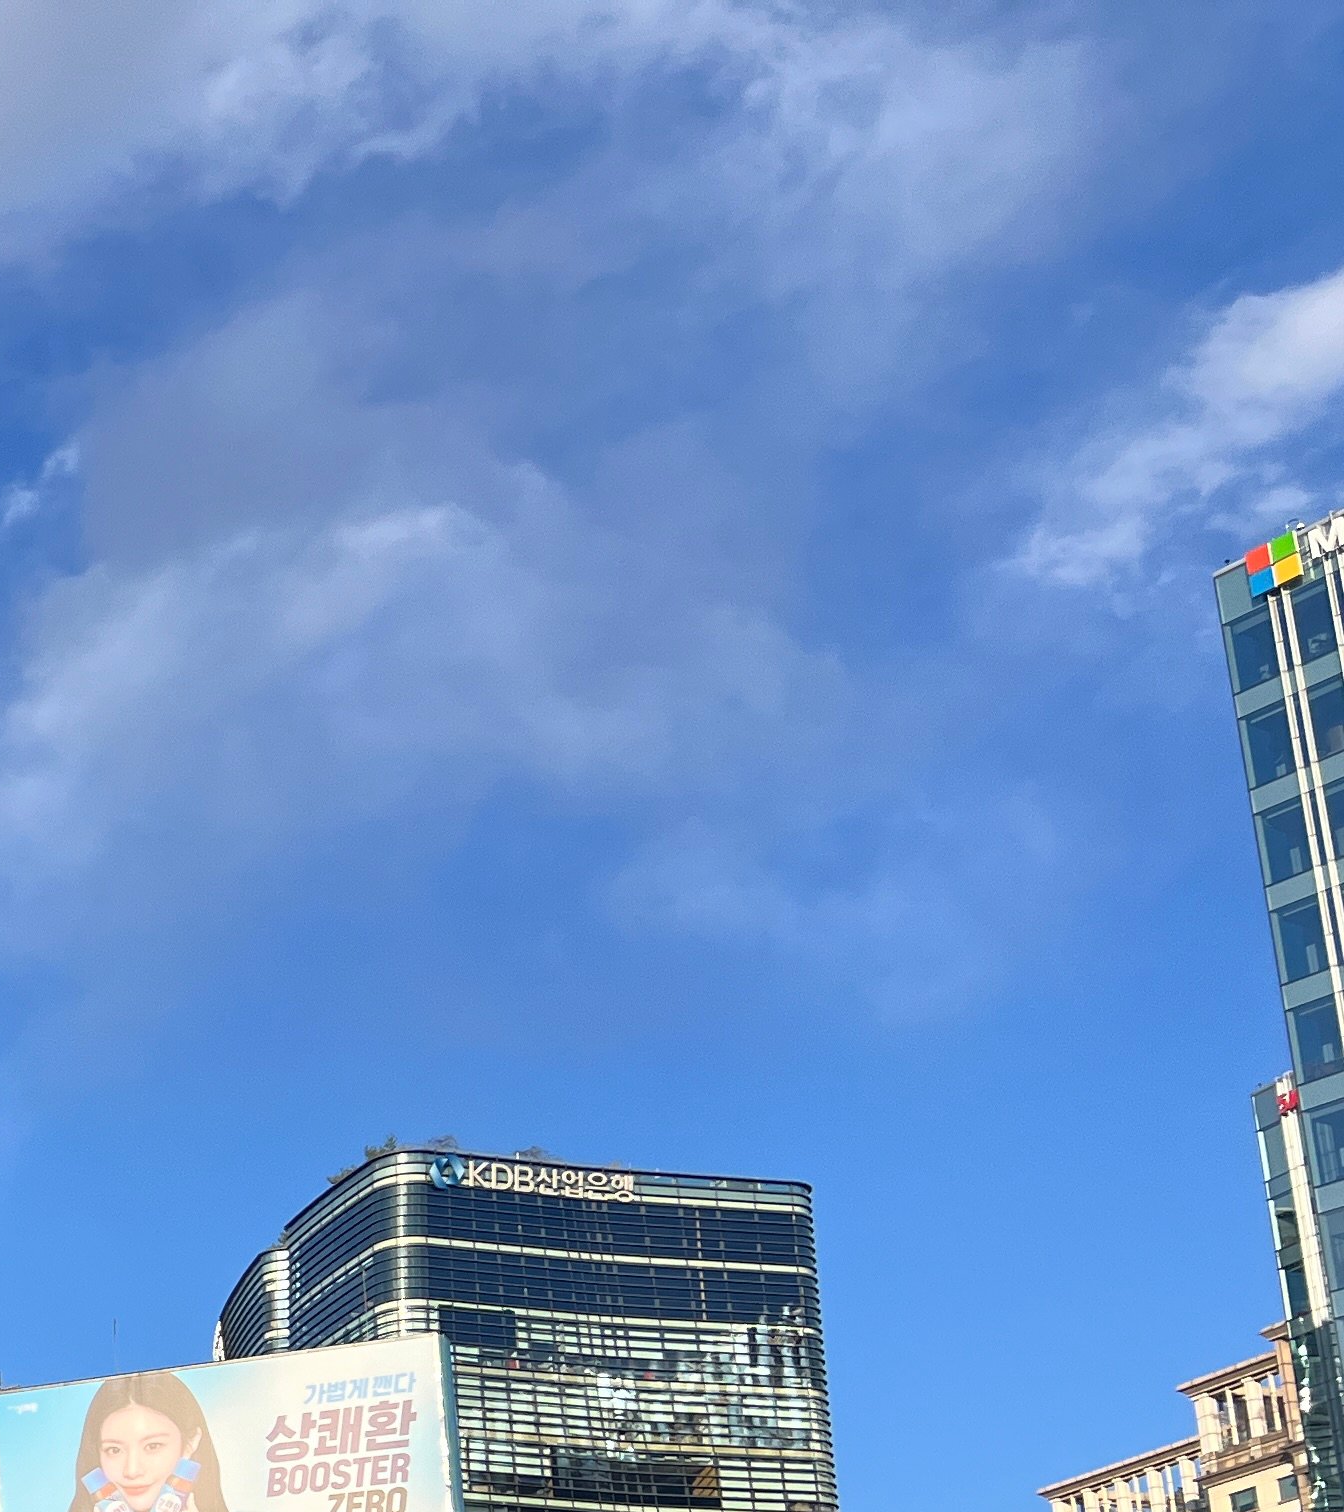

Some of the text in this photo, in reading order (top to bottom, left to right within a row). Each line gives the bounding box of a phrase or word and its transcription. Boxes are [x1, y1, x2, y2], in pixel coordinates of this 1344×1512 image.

[467, 1159, 636, 1204] KDB산업은행
[303, 1371, 418, 1405] 가볍게 깬다
[265, 1399, 418, 1464] 상쾌환
[266, 1452, 412, 1498] BOOSTER
